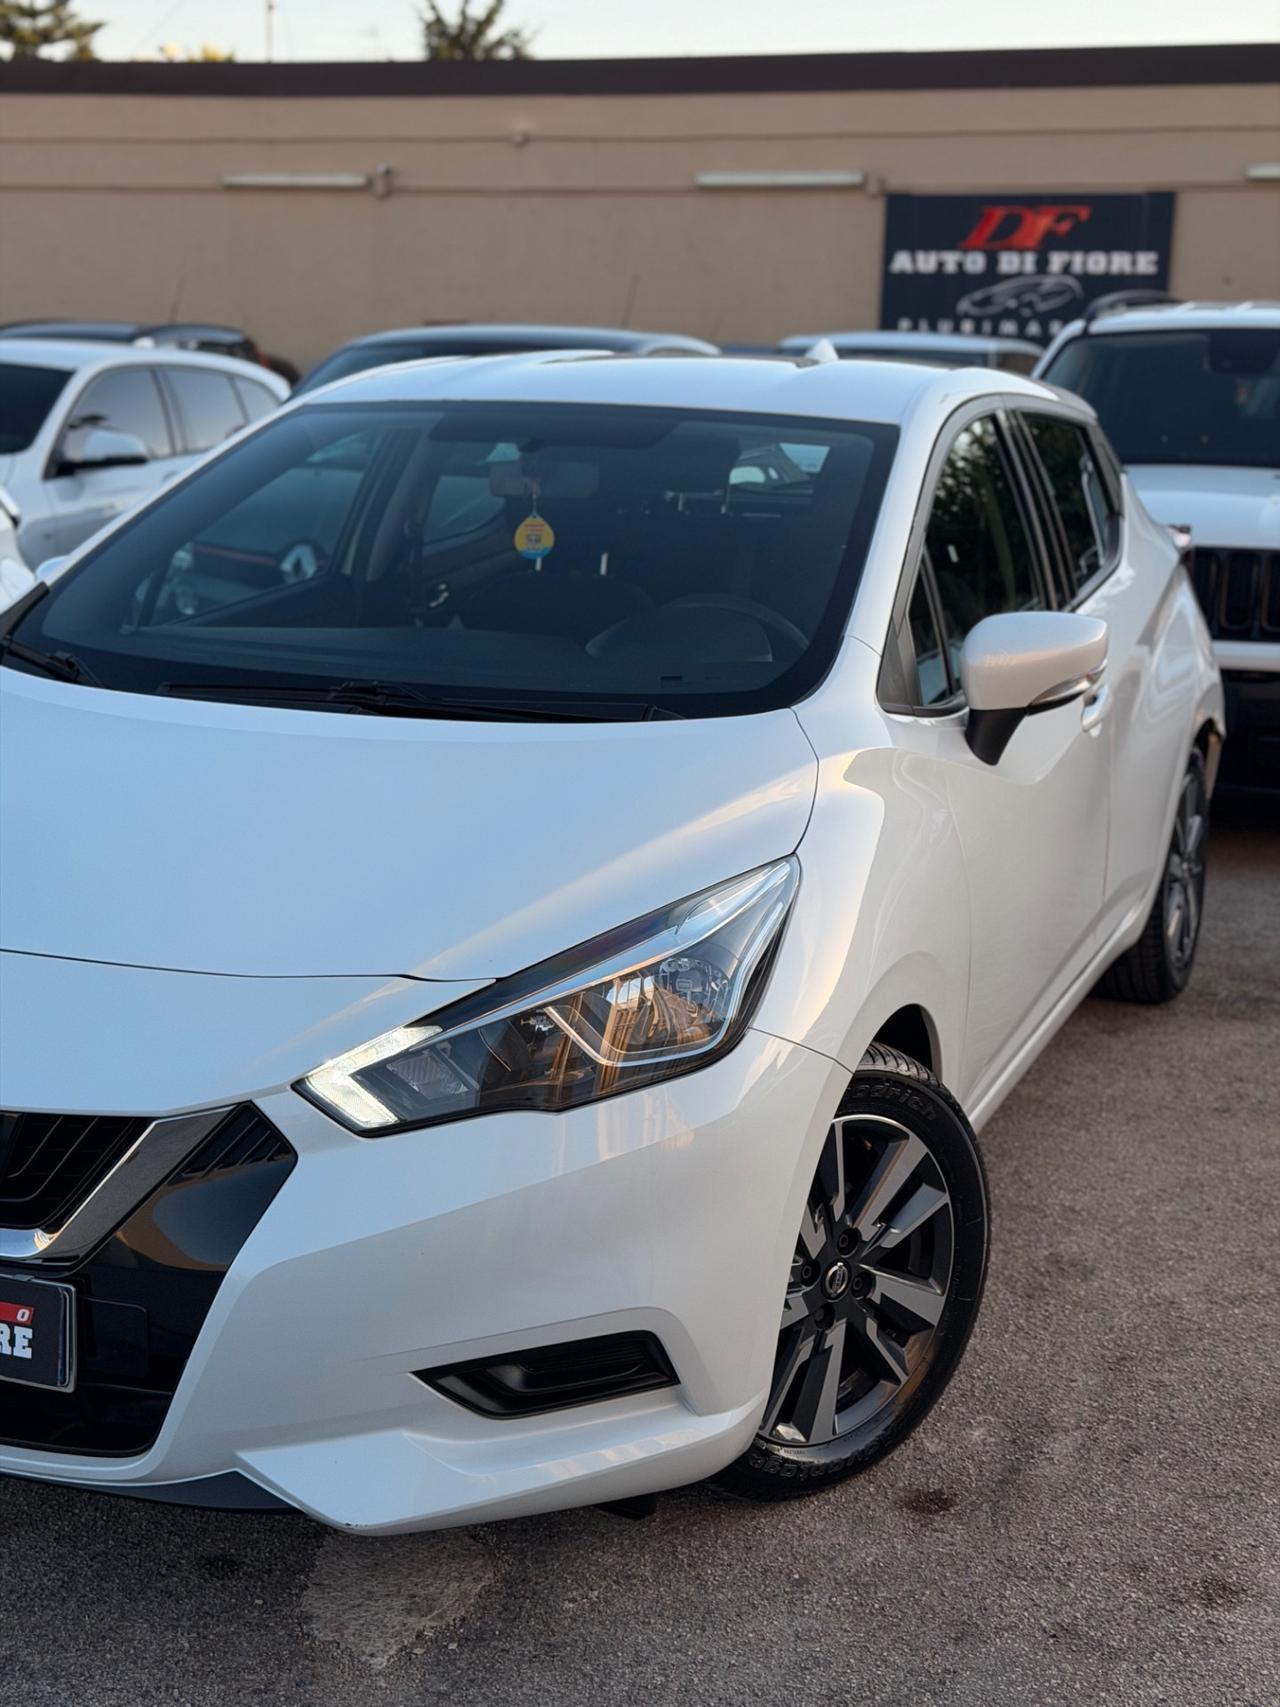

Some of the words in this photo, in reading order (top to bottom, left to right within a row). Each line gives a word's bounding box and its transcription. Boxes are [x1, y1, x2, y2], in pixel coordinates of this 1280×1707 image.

[960, 204, 1092, 250] DF
[889, 250, 986, 274] AUTO
[996, 251, 1037, 274] DI
[1048, 251, 1159, 275] FIORE
